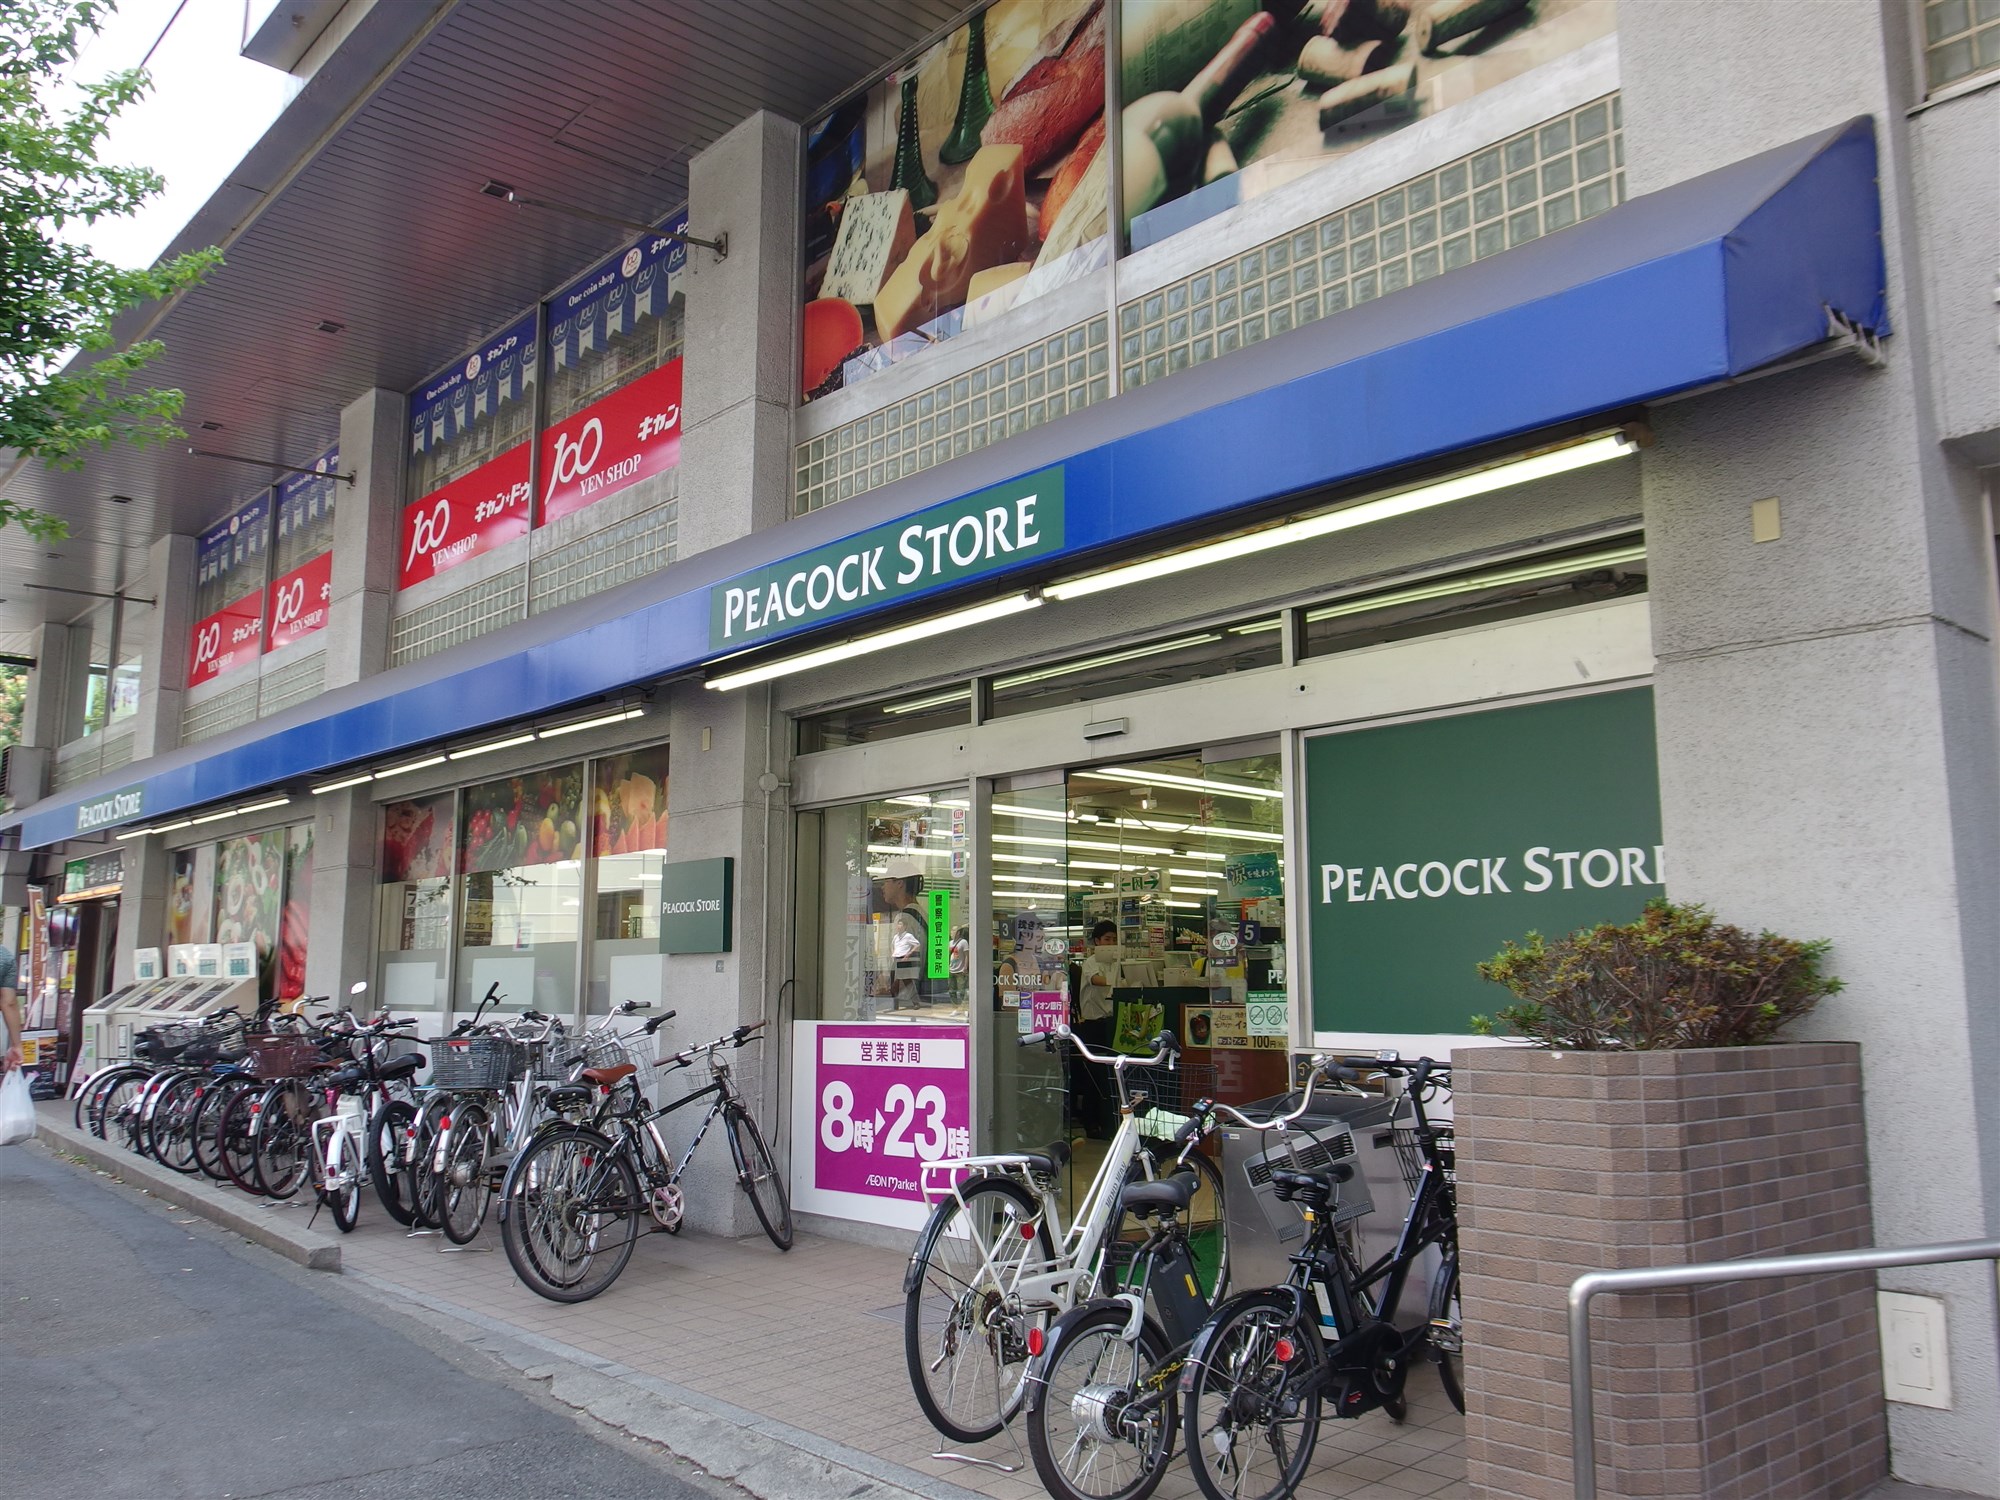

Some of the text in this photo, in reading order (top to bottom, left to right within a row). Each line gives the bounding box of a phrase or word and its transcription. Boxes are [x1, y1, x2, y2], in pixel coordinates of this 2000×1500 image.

[568, 272, 616, 307] One coin shop
[544, 417, 603, 506] 100
[579, 453, 642, 497] YEN SHOP
[405, 498, 451, 573] 100
[431, 532, 478, 568] YEN SHOP
[723, 493, 1042, 639] PEACOCK STORE
[271, 577, 305, 638] 100
[303, 608, 323, 630] SHOP
[192, 621, 220, 675] 100
[78, 791, 142, 829] PEACOCK STORE
[1320, 856, 1512, 904] PEACOCK
[662, 899, 720, 914] PEACOCK STORE
[934, 893, 944, 974] 警察官立寄所
[1002, 922, 1010, 937] 3
[1244, 924, 1255, 941] 5
[1012, 972, 1043, 986] STORE
[1034, 1001, 1063, 1011] イオン銀行
[1034, 1013, 1063, 1029] ATM
[860, 1040, 921, 1064] 営業時間
